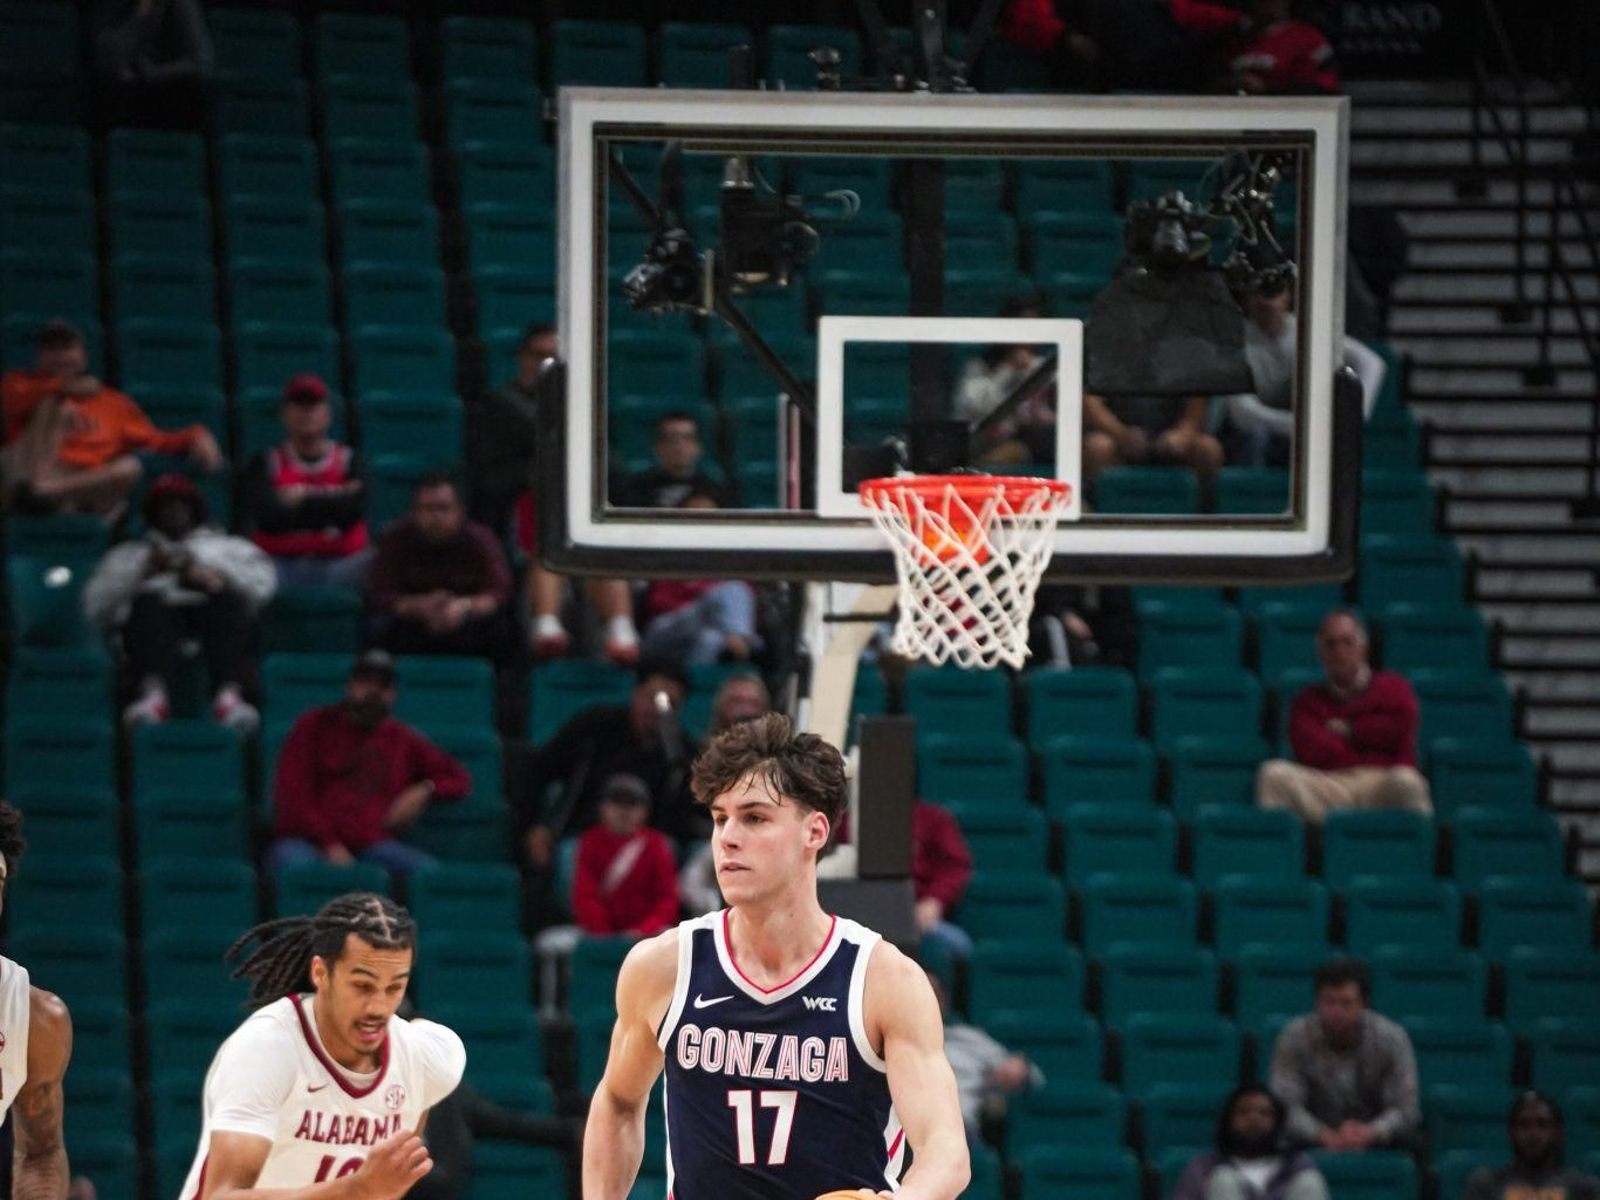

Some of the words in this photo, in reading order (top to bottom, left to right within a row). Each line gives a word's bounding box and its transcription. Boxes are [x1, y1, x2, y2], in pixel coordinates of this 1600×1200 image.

[802, 995, 838, 1012] WCC
[677, 1023, 849, 1083] GONZAGA
[727, 1089, 799, 1166] 17
